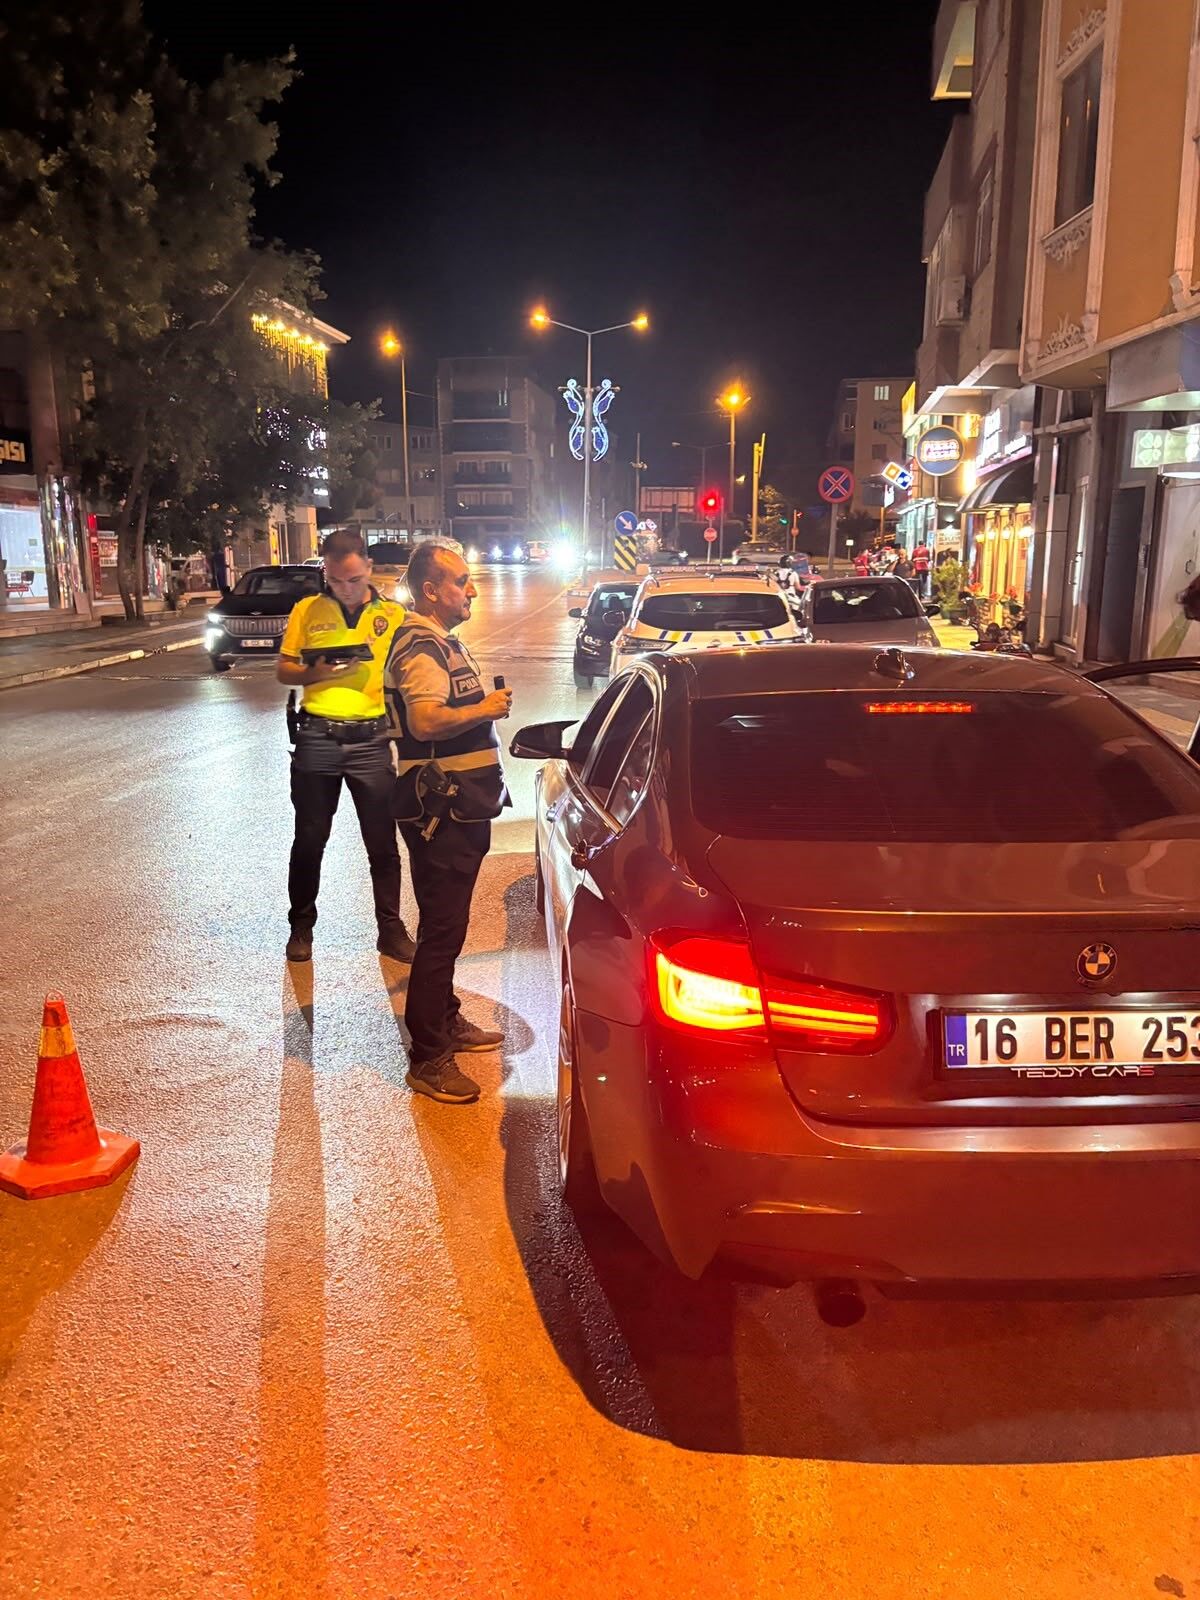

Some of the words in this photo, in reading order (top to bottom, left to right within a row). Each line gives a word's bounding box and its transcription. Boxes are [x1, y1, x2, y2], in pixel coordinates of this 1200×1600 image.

[975, 1018, 1017, 1060] 16
[1045, 1017, 1114, 1060] BER
[948, 1044, 965, 1057] TR
[1010, 1066, 1088, 1079] TEDDY
[1091, 1065, 1155, 1078] CARS
